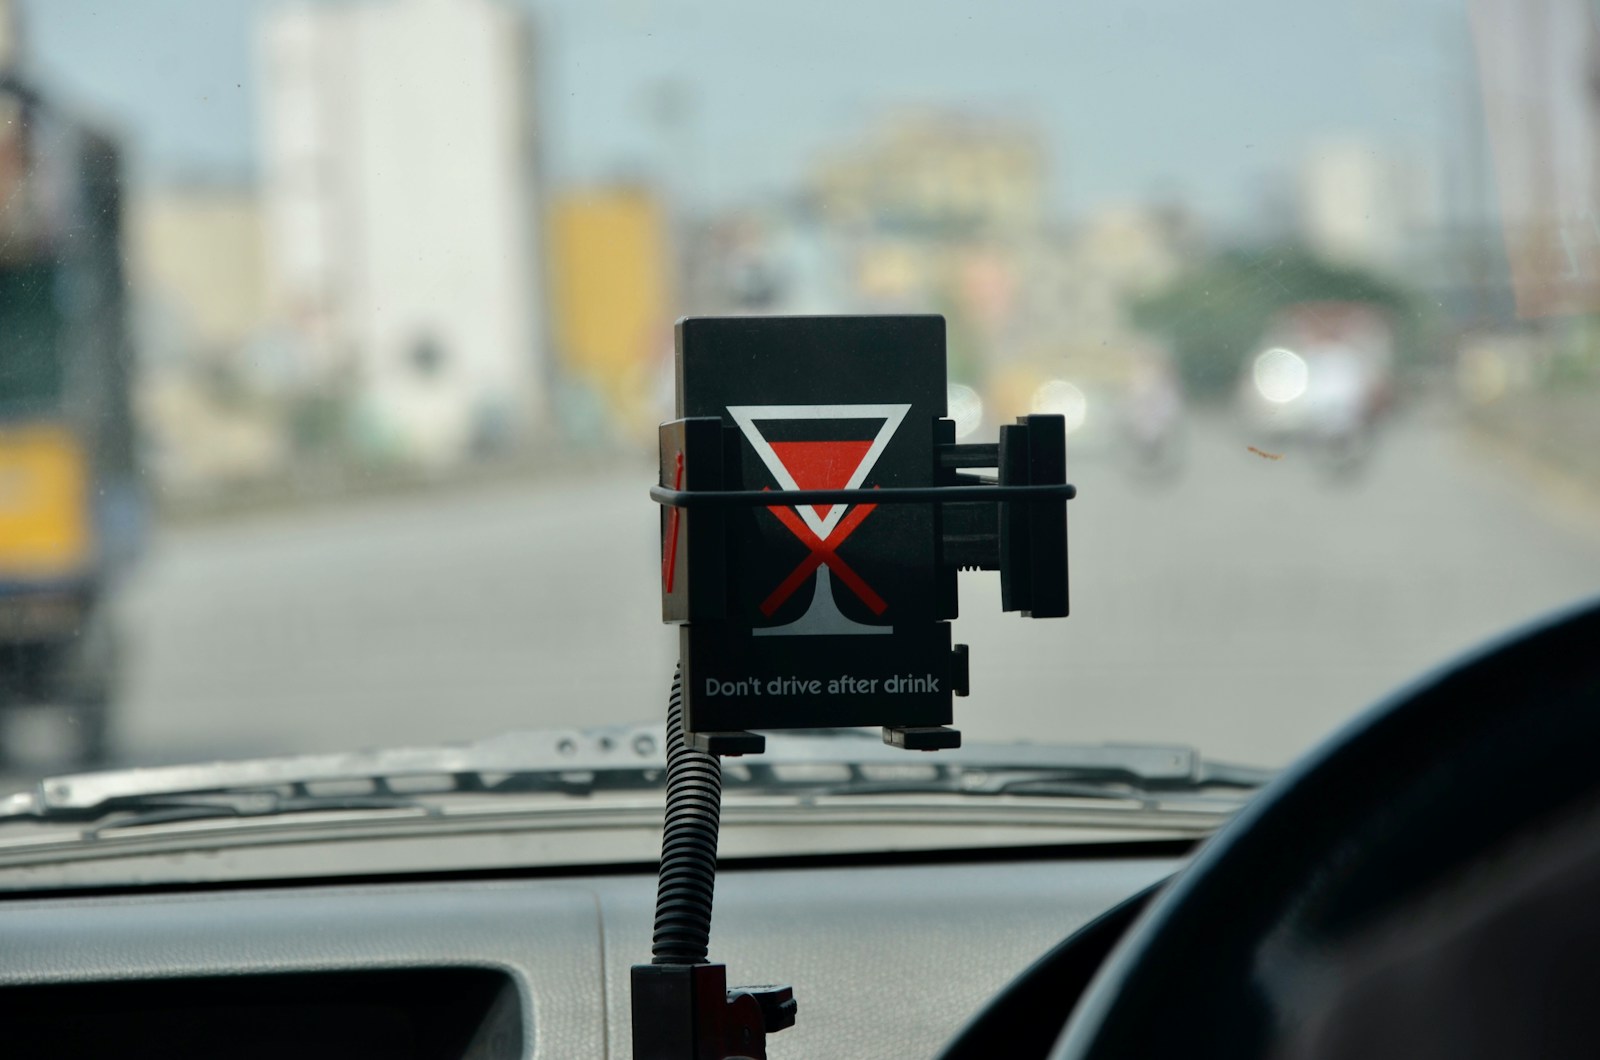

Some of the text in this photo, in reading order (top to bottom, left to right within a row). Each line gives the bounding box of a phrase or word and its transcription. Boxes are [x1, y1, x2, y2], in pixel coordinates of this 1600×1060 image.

[706, 673, 940, 697] Don't drive after drink
